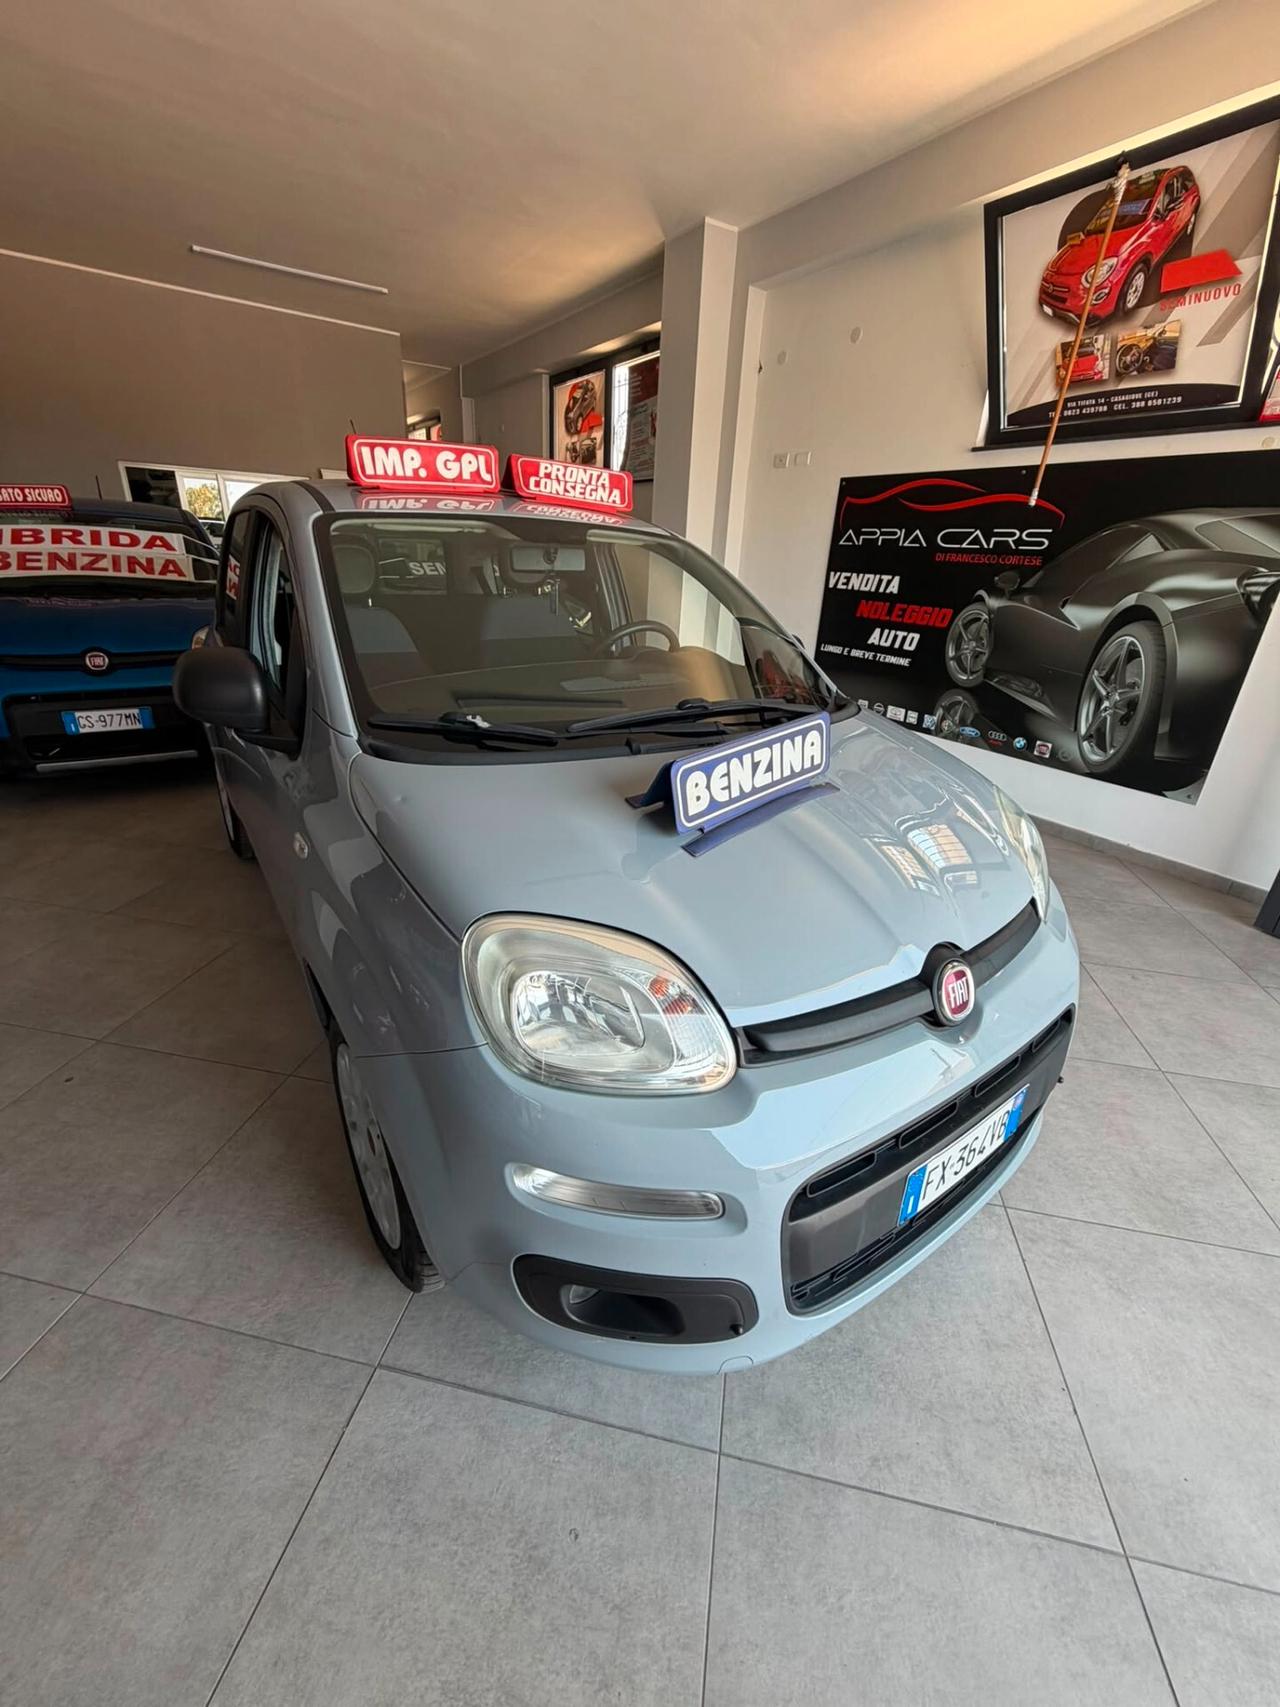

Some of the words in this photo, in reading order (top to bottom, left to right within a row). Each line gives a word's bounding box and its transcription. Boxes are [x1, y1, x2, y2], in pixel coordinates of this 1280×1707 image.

[360, 446, 428, 478] IMP.
[436, 451, 492, 482] GPL
[539, 462, 610, 487] PRONTA
[0, 488, 23, 502] ATO
[24, 488, 62, 502] SICURO
[529, 476, 621, 504] CONSEGNA
[0, 528, 177, 551] BRIDA
[839, 528, 927, 547] APPIA
[937, 528, 1053, 549] CARS
[935, 552, 944, 562] DI
[945, 553, 998, 564] FRANCESCO
[999, 554, 1043, 566] CORTESE
[828, 571, 900, 594] VENDITA
[856, 600, 953, 628] NOLEGGIO
[867, 627, 920, 651] AUTO
[821, 643, 842, 654] LUNGO
[850, 649, 875, 661] BREVE
[876, 652, 912, 667] TERMINE
[686, 730, 822, 816] BENZINA
[948, 976, 969, 1009] FIAT
